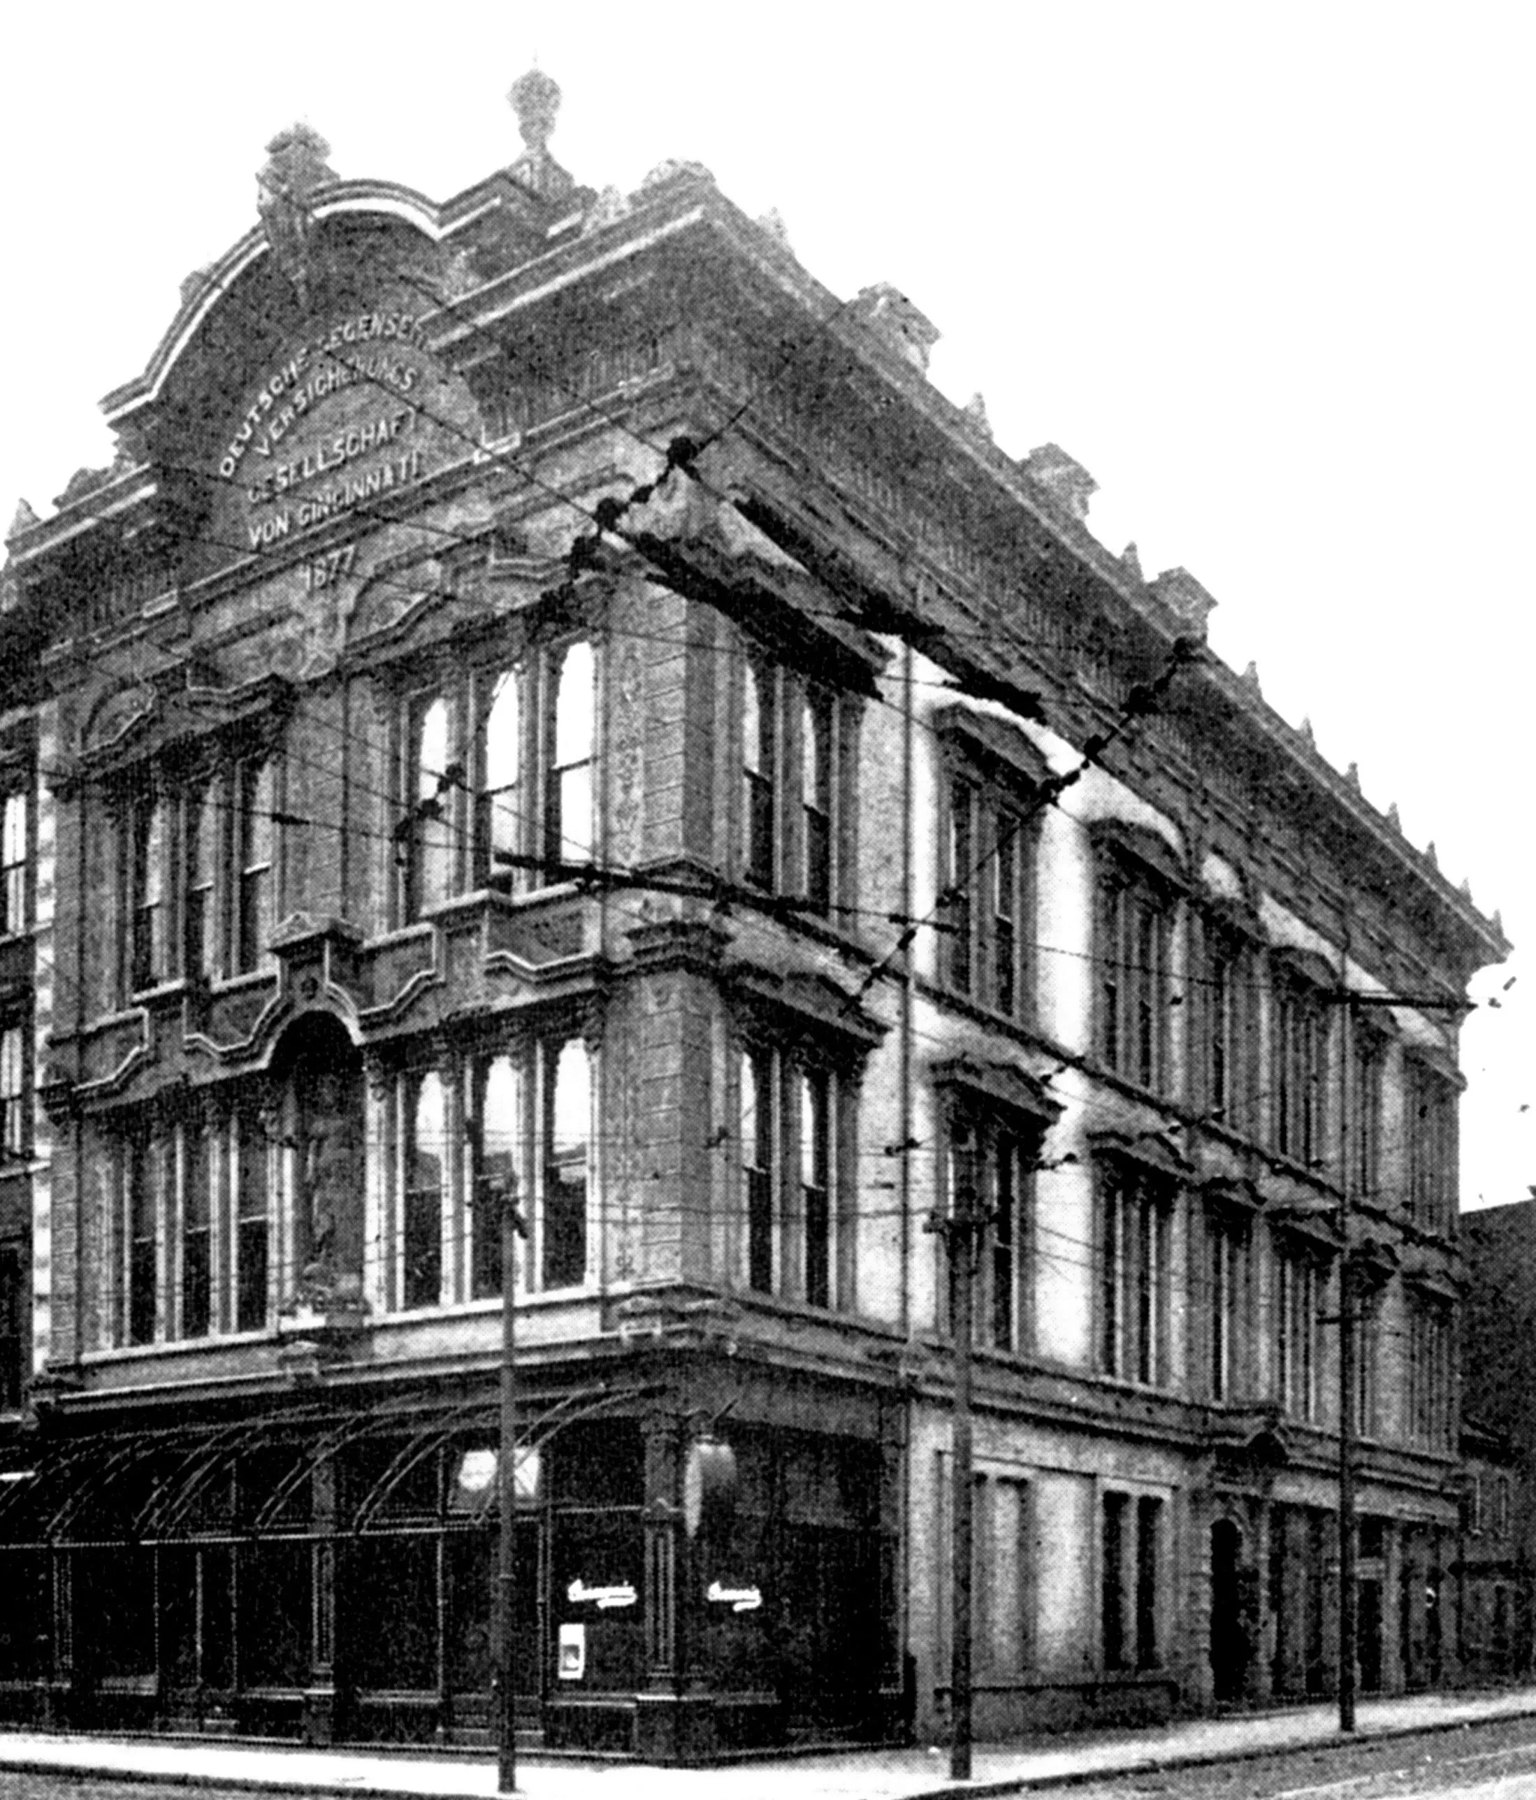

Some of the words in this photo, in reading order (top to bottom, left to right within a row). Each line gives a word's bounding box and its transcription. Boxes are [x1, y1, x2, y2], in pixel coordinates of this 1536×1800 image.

[219, 346, 310, 478] DEUTSCHE
[249, 510, 289, 546] VON
[295, 543, 356, 591] 1877
